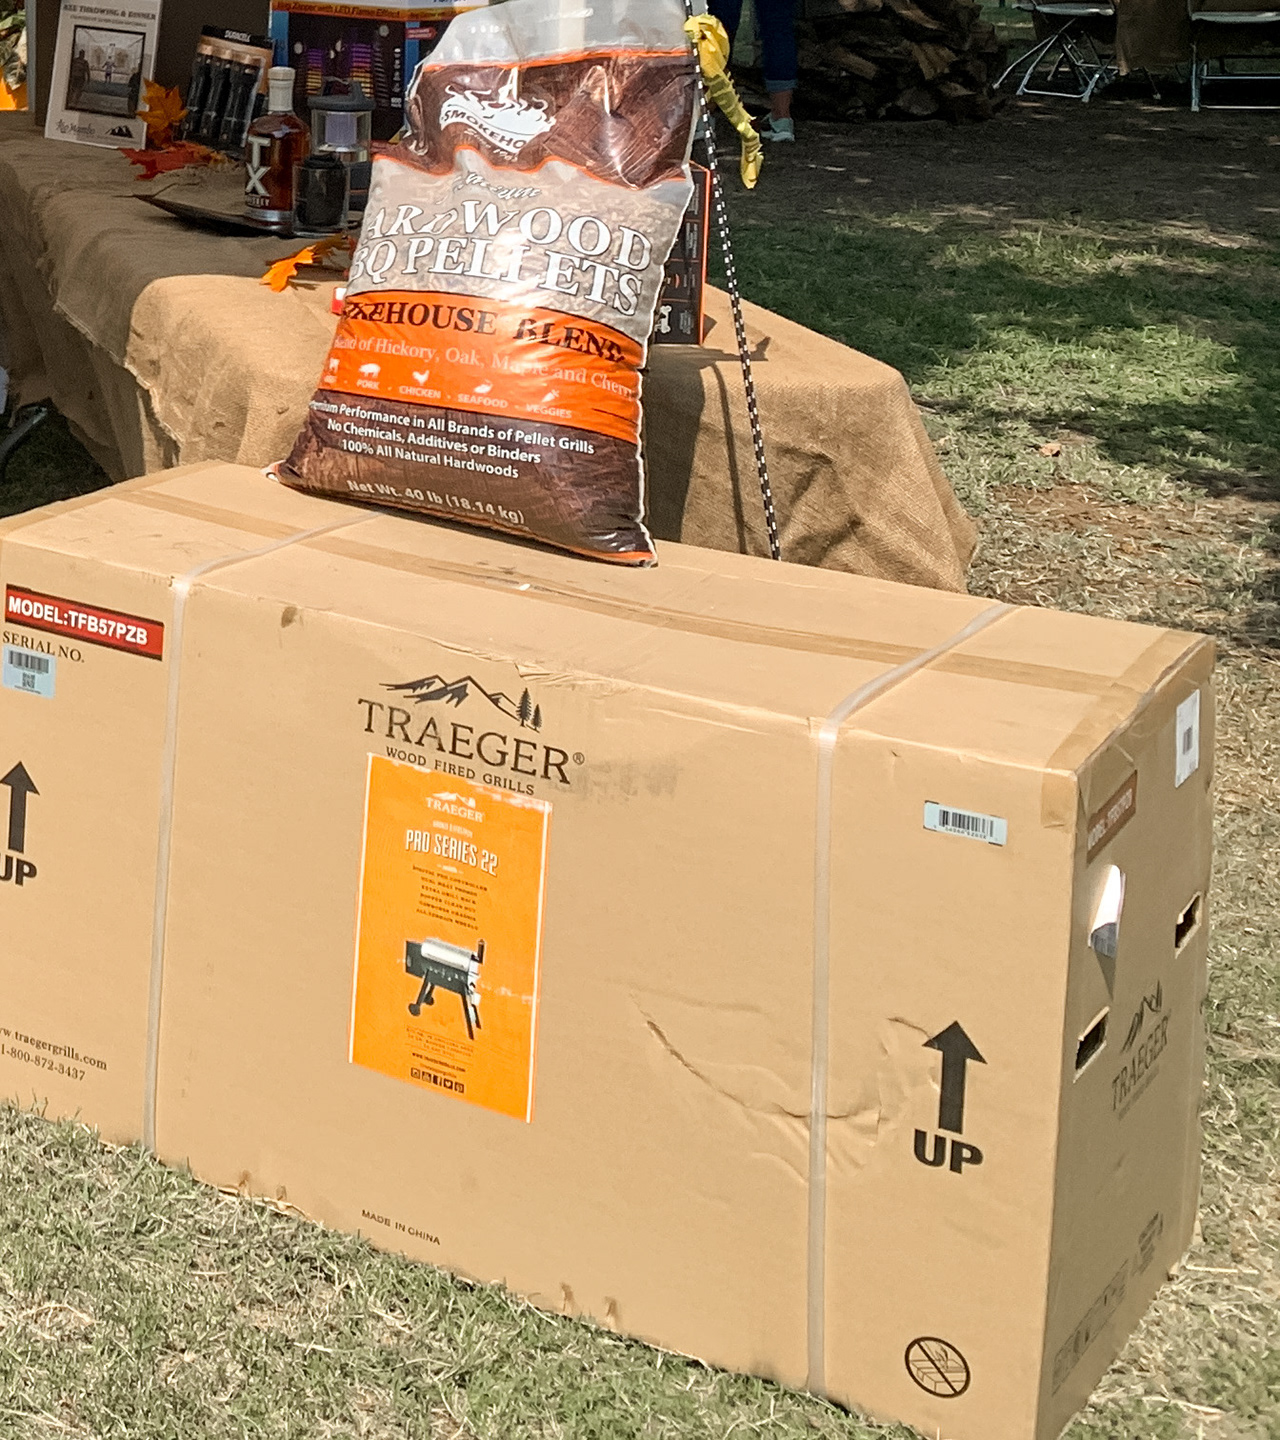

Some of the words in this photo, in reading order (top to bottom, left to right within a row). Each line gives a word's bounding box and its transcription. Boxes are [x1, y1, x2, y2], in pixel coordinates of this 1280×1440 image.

[366, 200, 652, 272] ARDWOOD
[402, 237, 642, 316] PELLETS
[376, 338, 440, 362] Hickory,
[445, 348, 484, 368] Oak,
[492, 353, 549, 379] Maple
[554, 365, 587, 384] and
[356, 379, 381, 391] PORK
[399, 386, 441, 399] CHICKEN
[458, 393, 509, 409] SEAFOOD
[339, 404, 410, 427] Performance
[428, 418, 445, 432] All
[449, 422, 495, 439] Brands
[497, 428, 513, 442] of
[515, 431, 556, 448] Pellet
[559, 437, 595, 455] Grills
[526, 403, 572, 419] VEGGIES
[327, 418, 342, 432] No
[343, 422, 405, 444] Chemicals,
[407, 432, 468, 453] Additives
[487, 445, 542, 464] Binders
[341, 439, 374, 455] 100%
[376, 444, 392, 458] All
[395, 447, 441, 465] Natural
[443, 455, 519, 479] Hardwoods
[346, 479, 375, 494] Net
[378, 483, 403, 498] Wt.
[405, 488, 424, 501] 40
[427, 491, 443, 505] lb
[445, 493, 495, 516] (18.14
[498, 505, 525, 525] kg)
[8, 596, 148, 645] MODEL:TFB57PZB
[3, 631, 55, 656] SERIAL
[58, 644, 85, 663] NO.
[358, 698, 571, 785] TRAEGER
[386, 746, 426, 766] WOOD
[434, 760, 476, 780] FIRED
[483, 773, 535, 796] GRILLS
[425, 797, 483, 823] TRAEGER
[406, 829, 430, 852] PRO
[434, 834, 477, 867] SERIES
[481, 850, 498, 876] 22
[1, 1043, 85, 1081] 1-800-872-3437
[912, 1128, 984, 1175] UP
[362, 1209, 391, 1227] MADE
[395, 1222, 406, 1232] IN
[407, 1227, 441, 1245] CHINA
